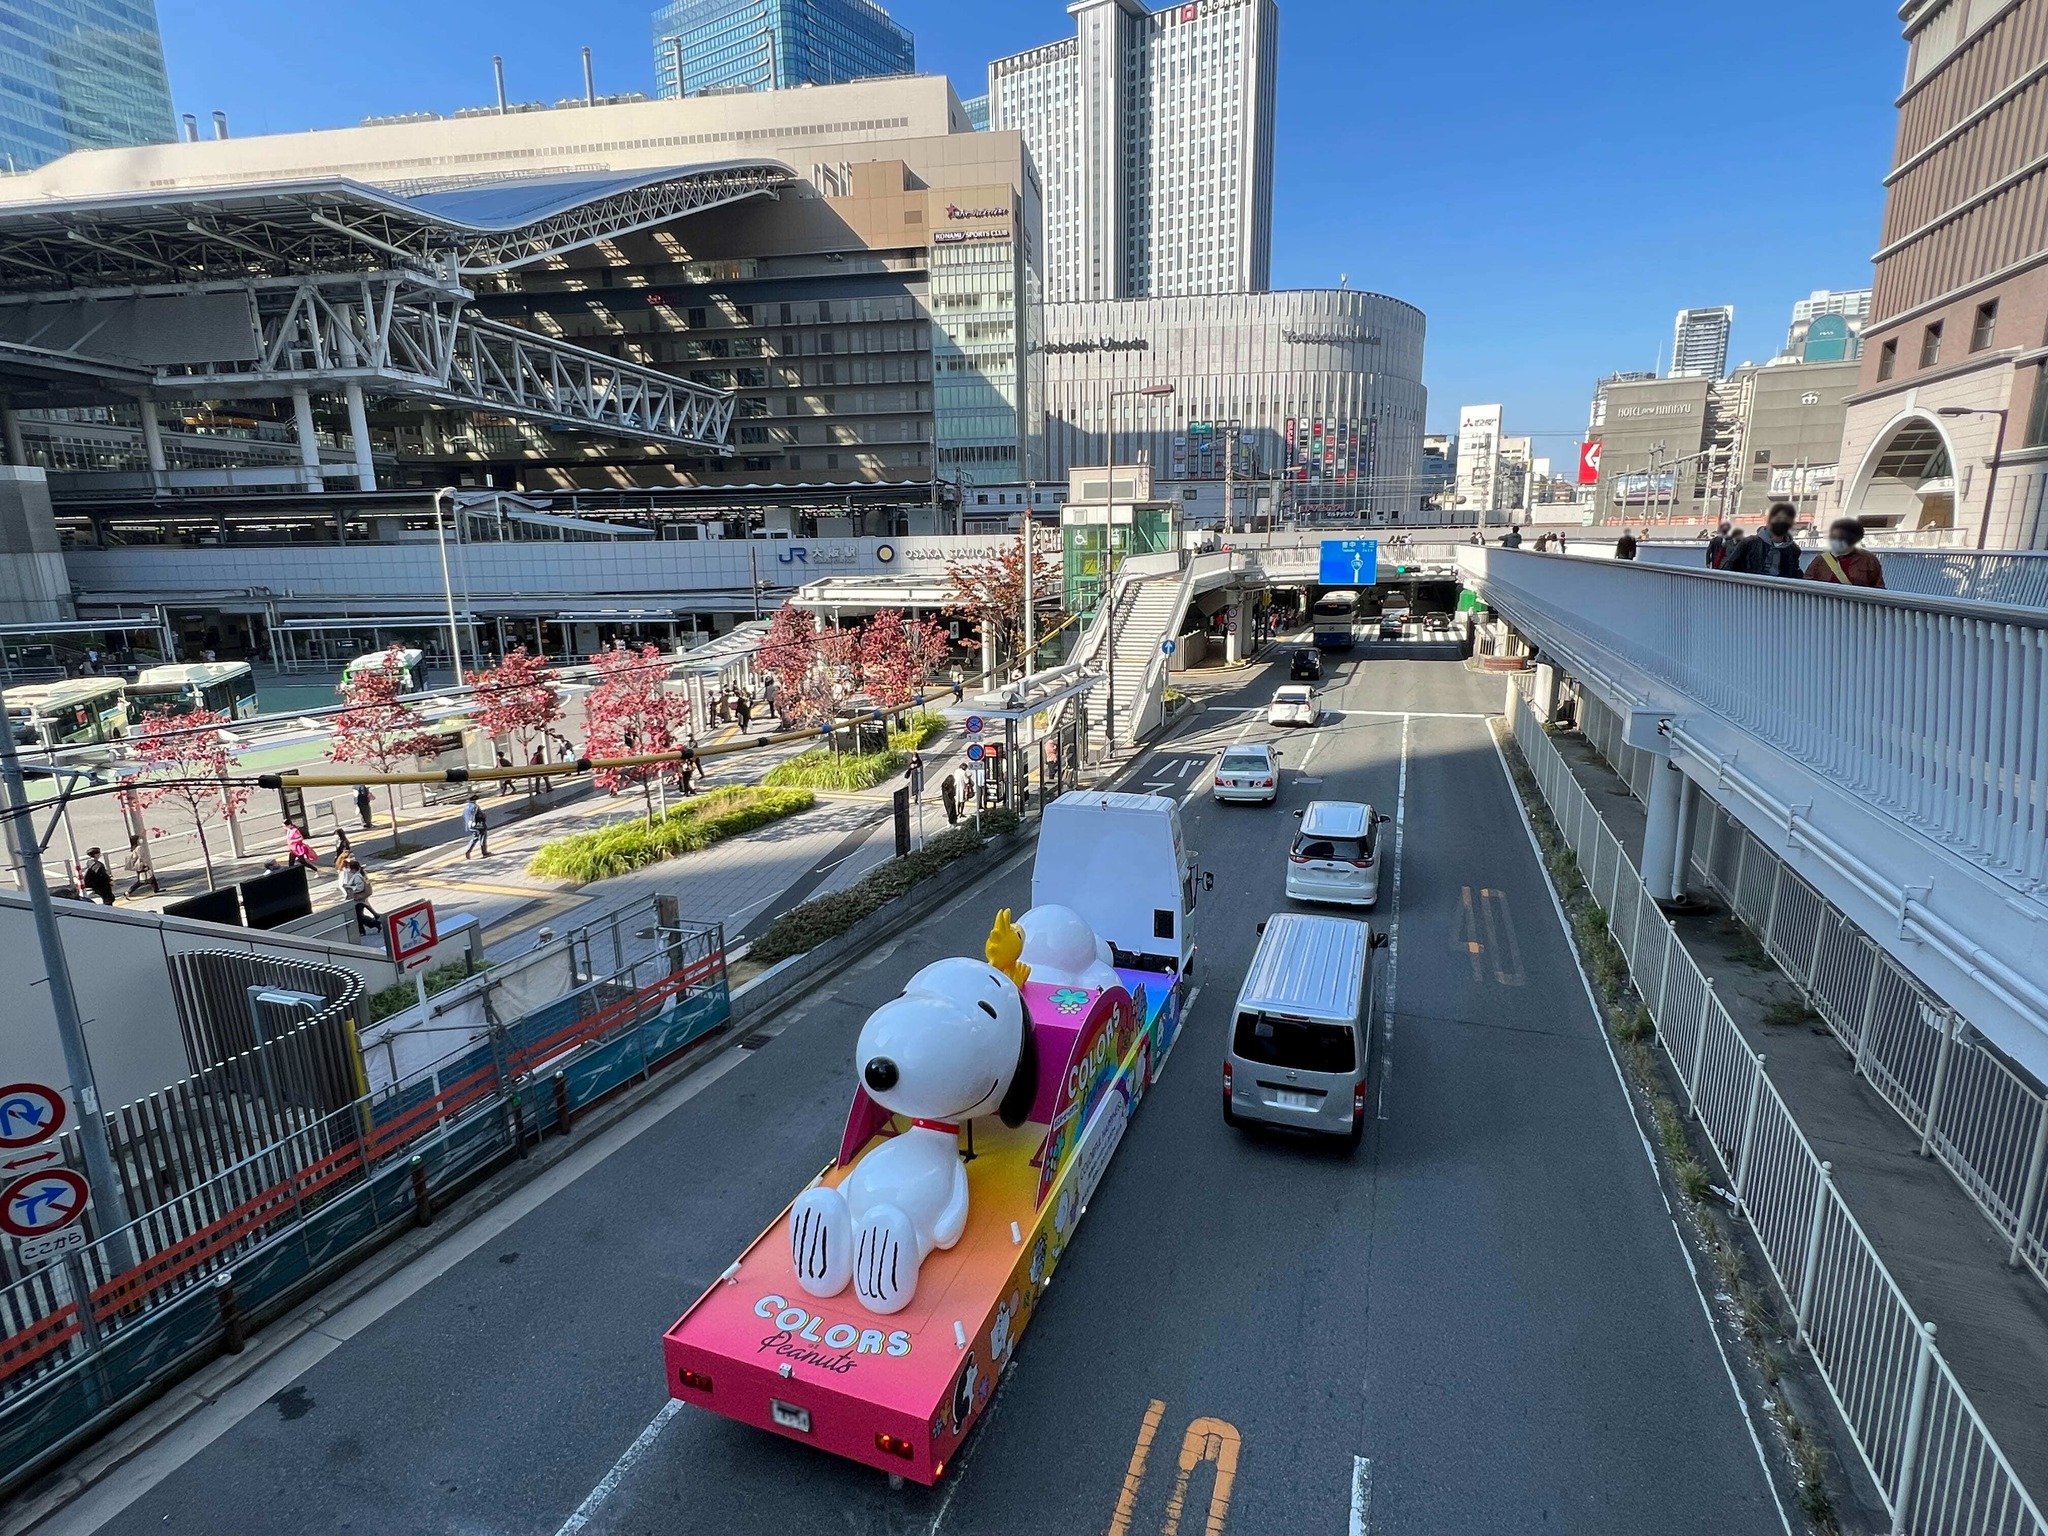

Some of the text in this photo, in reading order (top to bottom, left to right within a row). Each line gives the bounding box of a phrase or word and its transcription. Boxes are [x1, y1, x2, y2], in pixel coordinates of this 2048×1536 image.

[935, 229, 1008, 240] KONAMI SPORTS CLUB
[1617, 407, 1642, 418] HOTEL
[1655, 403, 1691, 415] HANKYU
[779, 547, 807, 563] JR
[812, 546, 857, 558] 大阪駅
[905, 547, 943, 560] OSAKA
[948, 546, 994, 559] STATION
[1067, 1001, 1120, 1099] COLORS
[24, 1232, 82, 1260] ここから
[754, 1294, 912, 1357] COLORS
[756, 1330, 858, 1374] Peanuts
